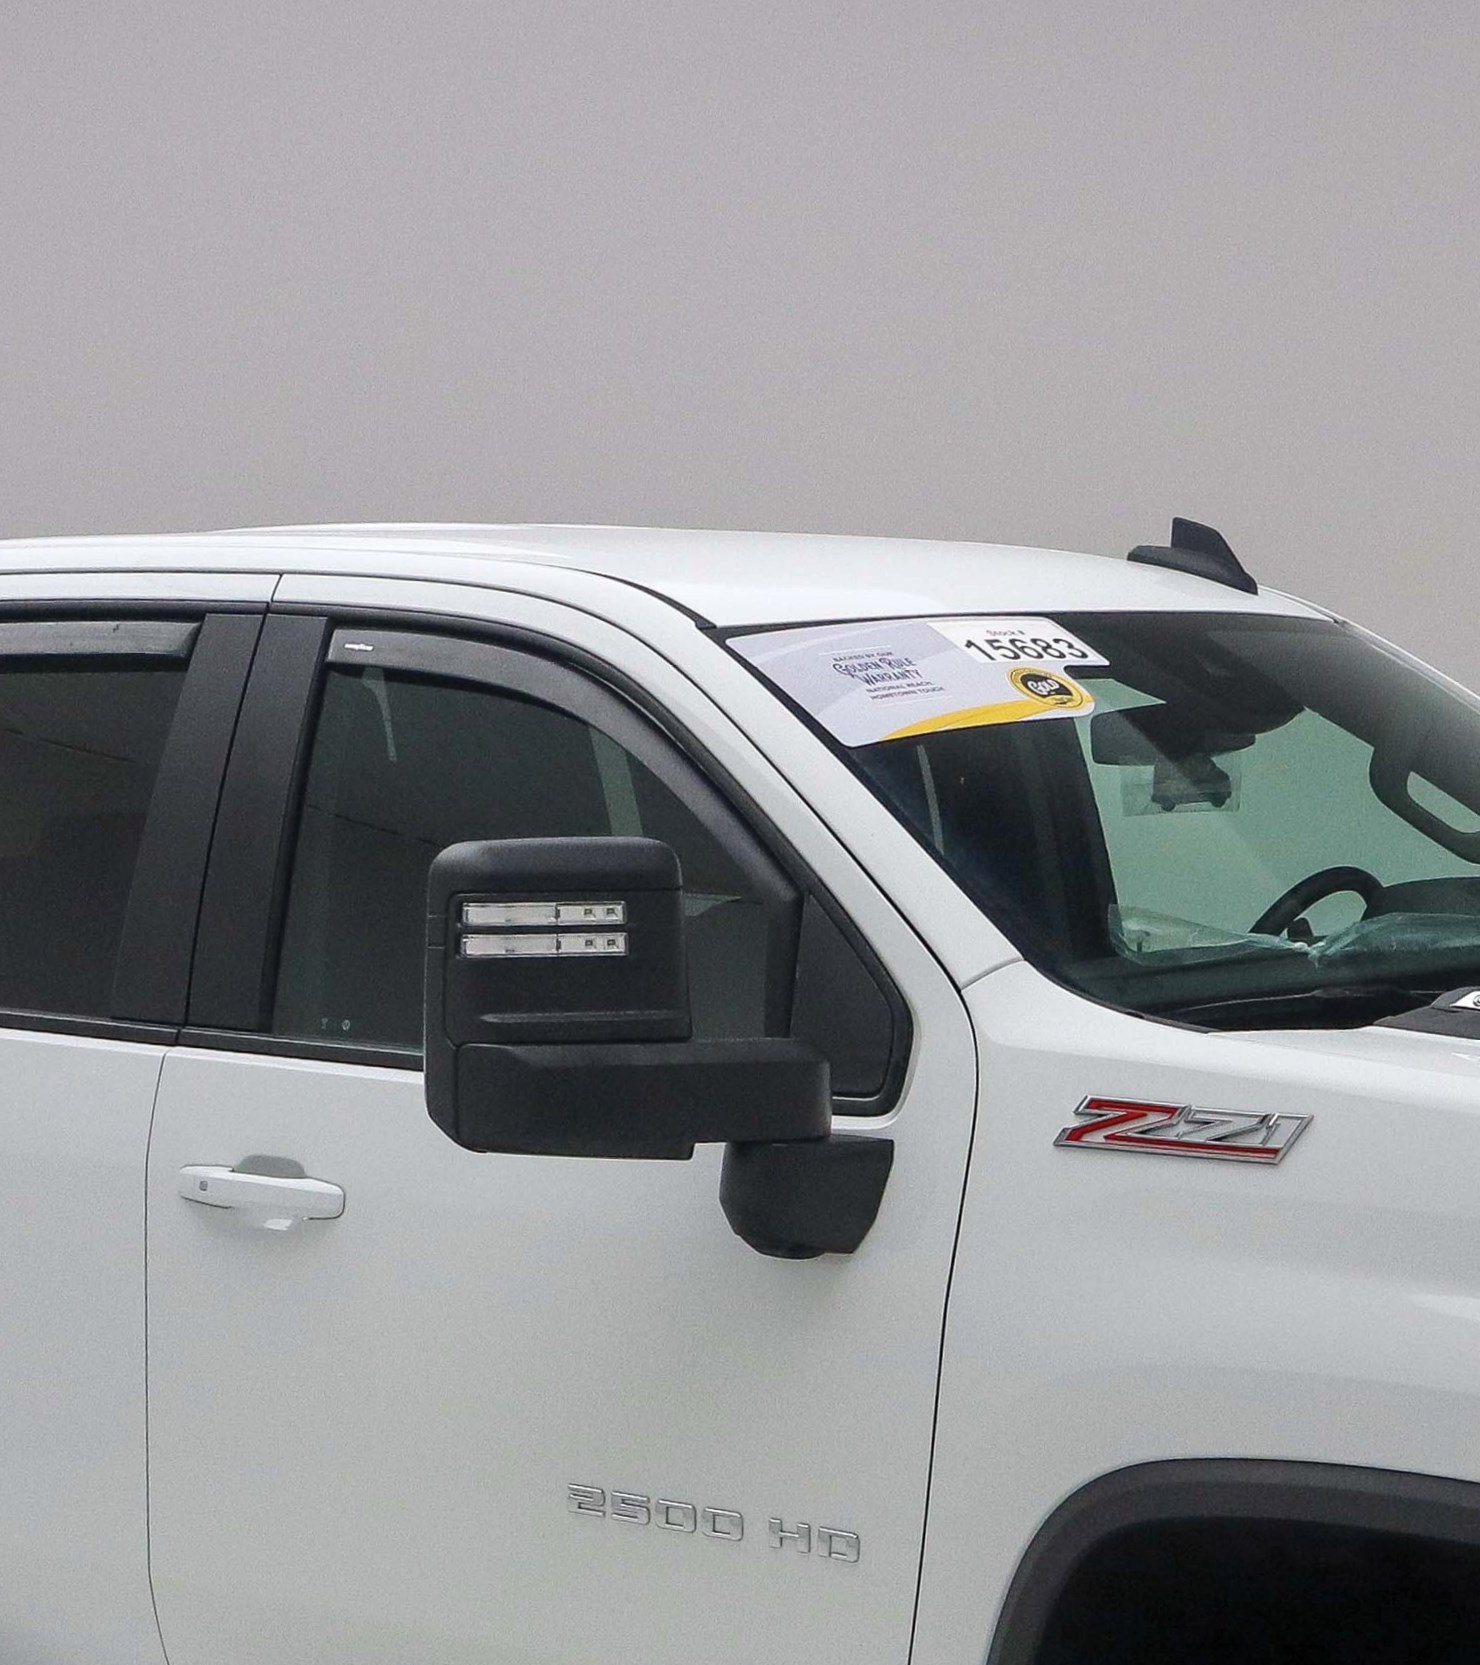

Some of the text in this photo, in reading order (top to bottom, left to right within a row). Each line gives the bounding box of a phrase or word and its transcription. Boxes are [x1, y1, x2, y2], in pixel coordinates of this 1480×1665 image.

[965, 638, 1089, 661] 15683
[832, 657, 917, 679] GOLDEN RULE
[856, 669, 923, 686] WARRANTY
[1026, 678, 1061, 695] GOLD
[1054, 1096, 1313, 1164] Z71
[568, 1482, 861, 1563] 2500 HD
